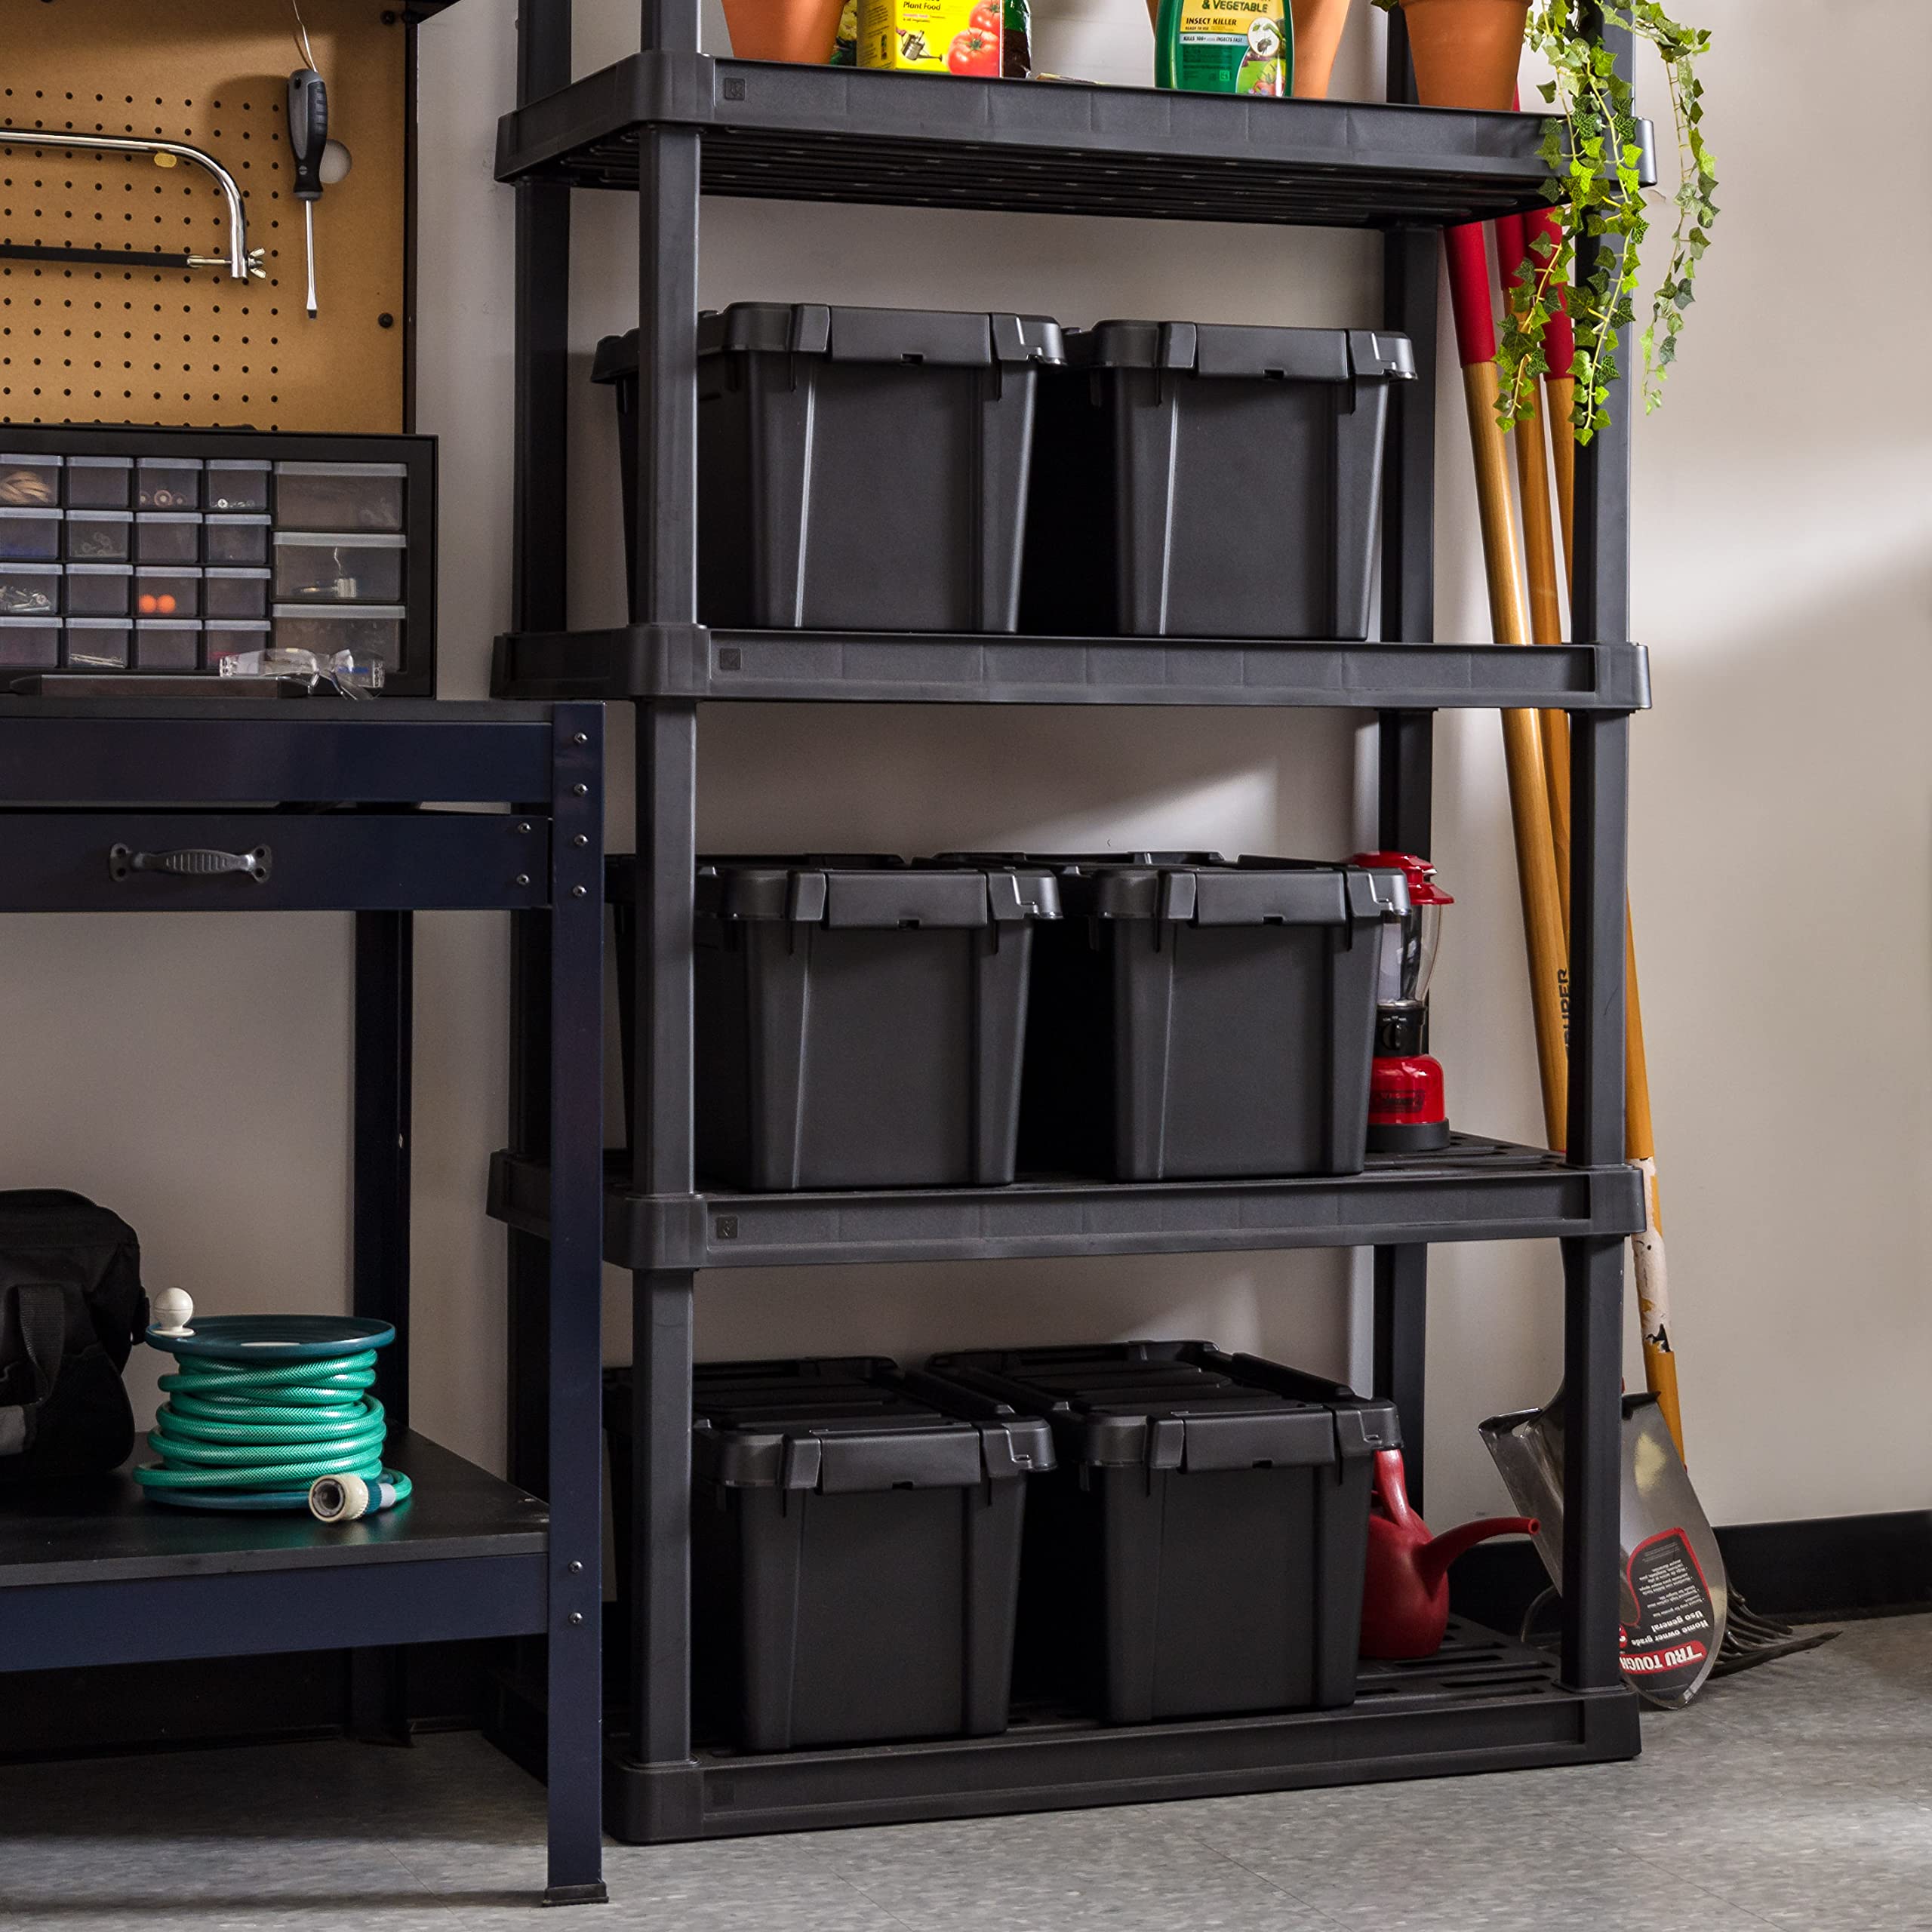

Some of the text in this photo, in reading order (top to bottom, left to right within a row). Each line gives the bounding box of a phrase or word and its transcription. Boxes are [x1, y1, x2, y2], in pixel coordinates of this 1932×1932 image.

[924, 2, 941, 11] Food
[1202, 0, 1268, 13] & VEGETABLE
[1651, 1610, 1703, 1632] Uso general
[1681, 1620, 1709, 1633] Home
[1632, 1635, 1654, 1647] grade
[1655, 1629, 1681, 1641] owner
[1664, 1645, 1703, 1667] TRU
